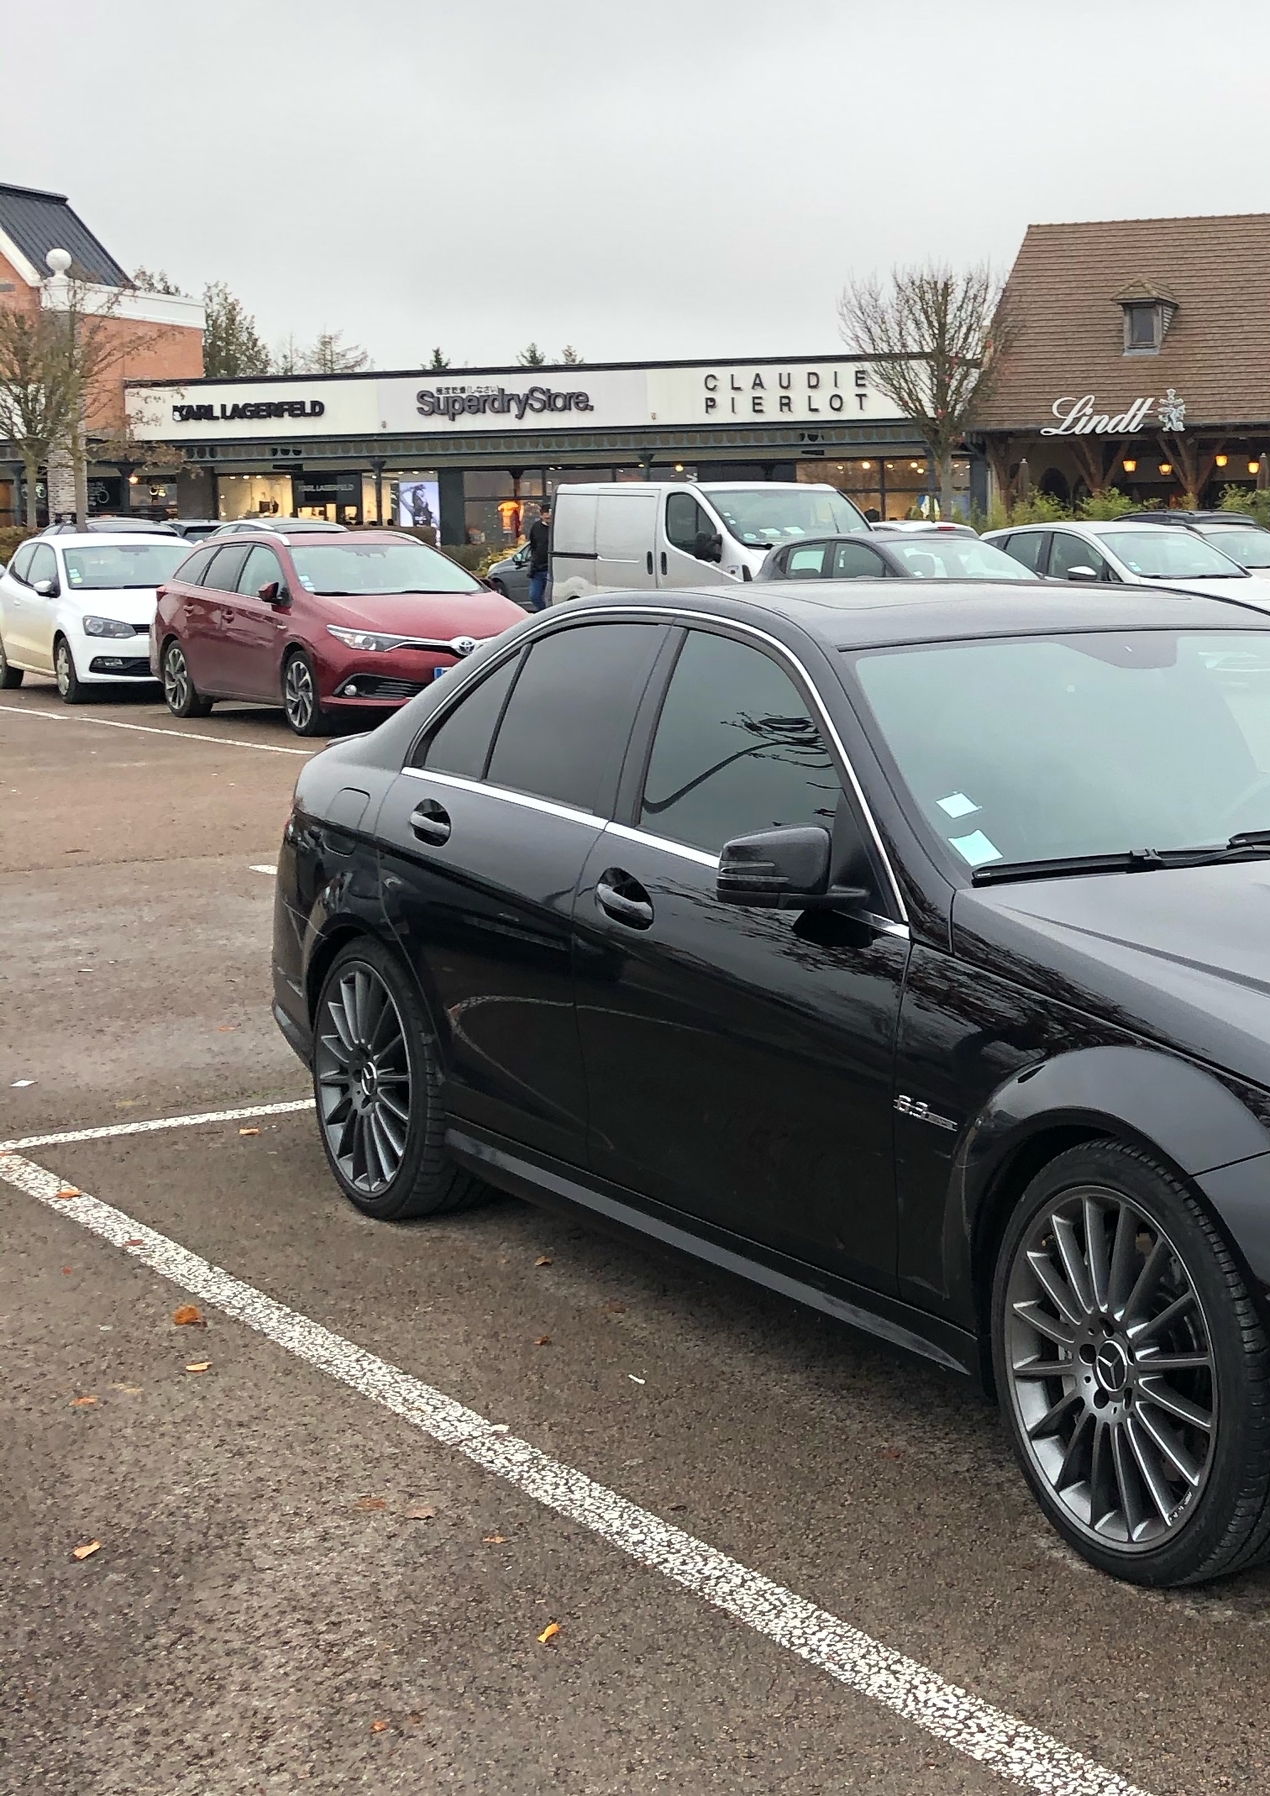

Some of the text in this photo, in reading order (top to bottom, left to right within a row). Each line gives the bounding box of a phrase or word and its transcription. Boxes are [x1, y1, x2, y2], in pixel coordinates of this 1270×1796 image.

[704, 370, 868, 392] CLAUDIE
[172, 400, 325, 422] KARL LAGERFELD
[704, 393, 868, 414] PIERLOT
[1040, 394, 1156, 436] Lindt
